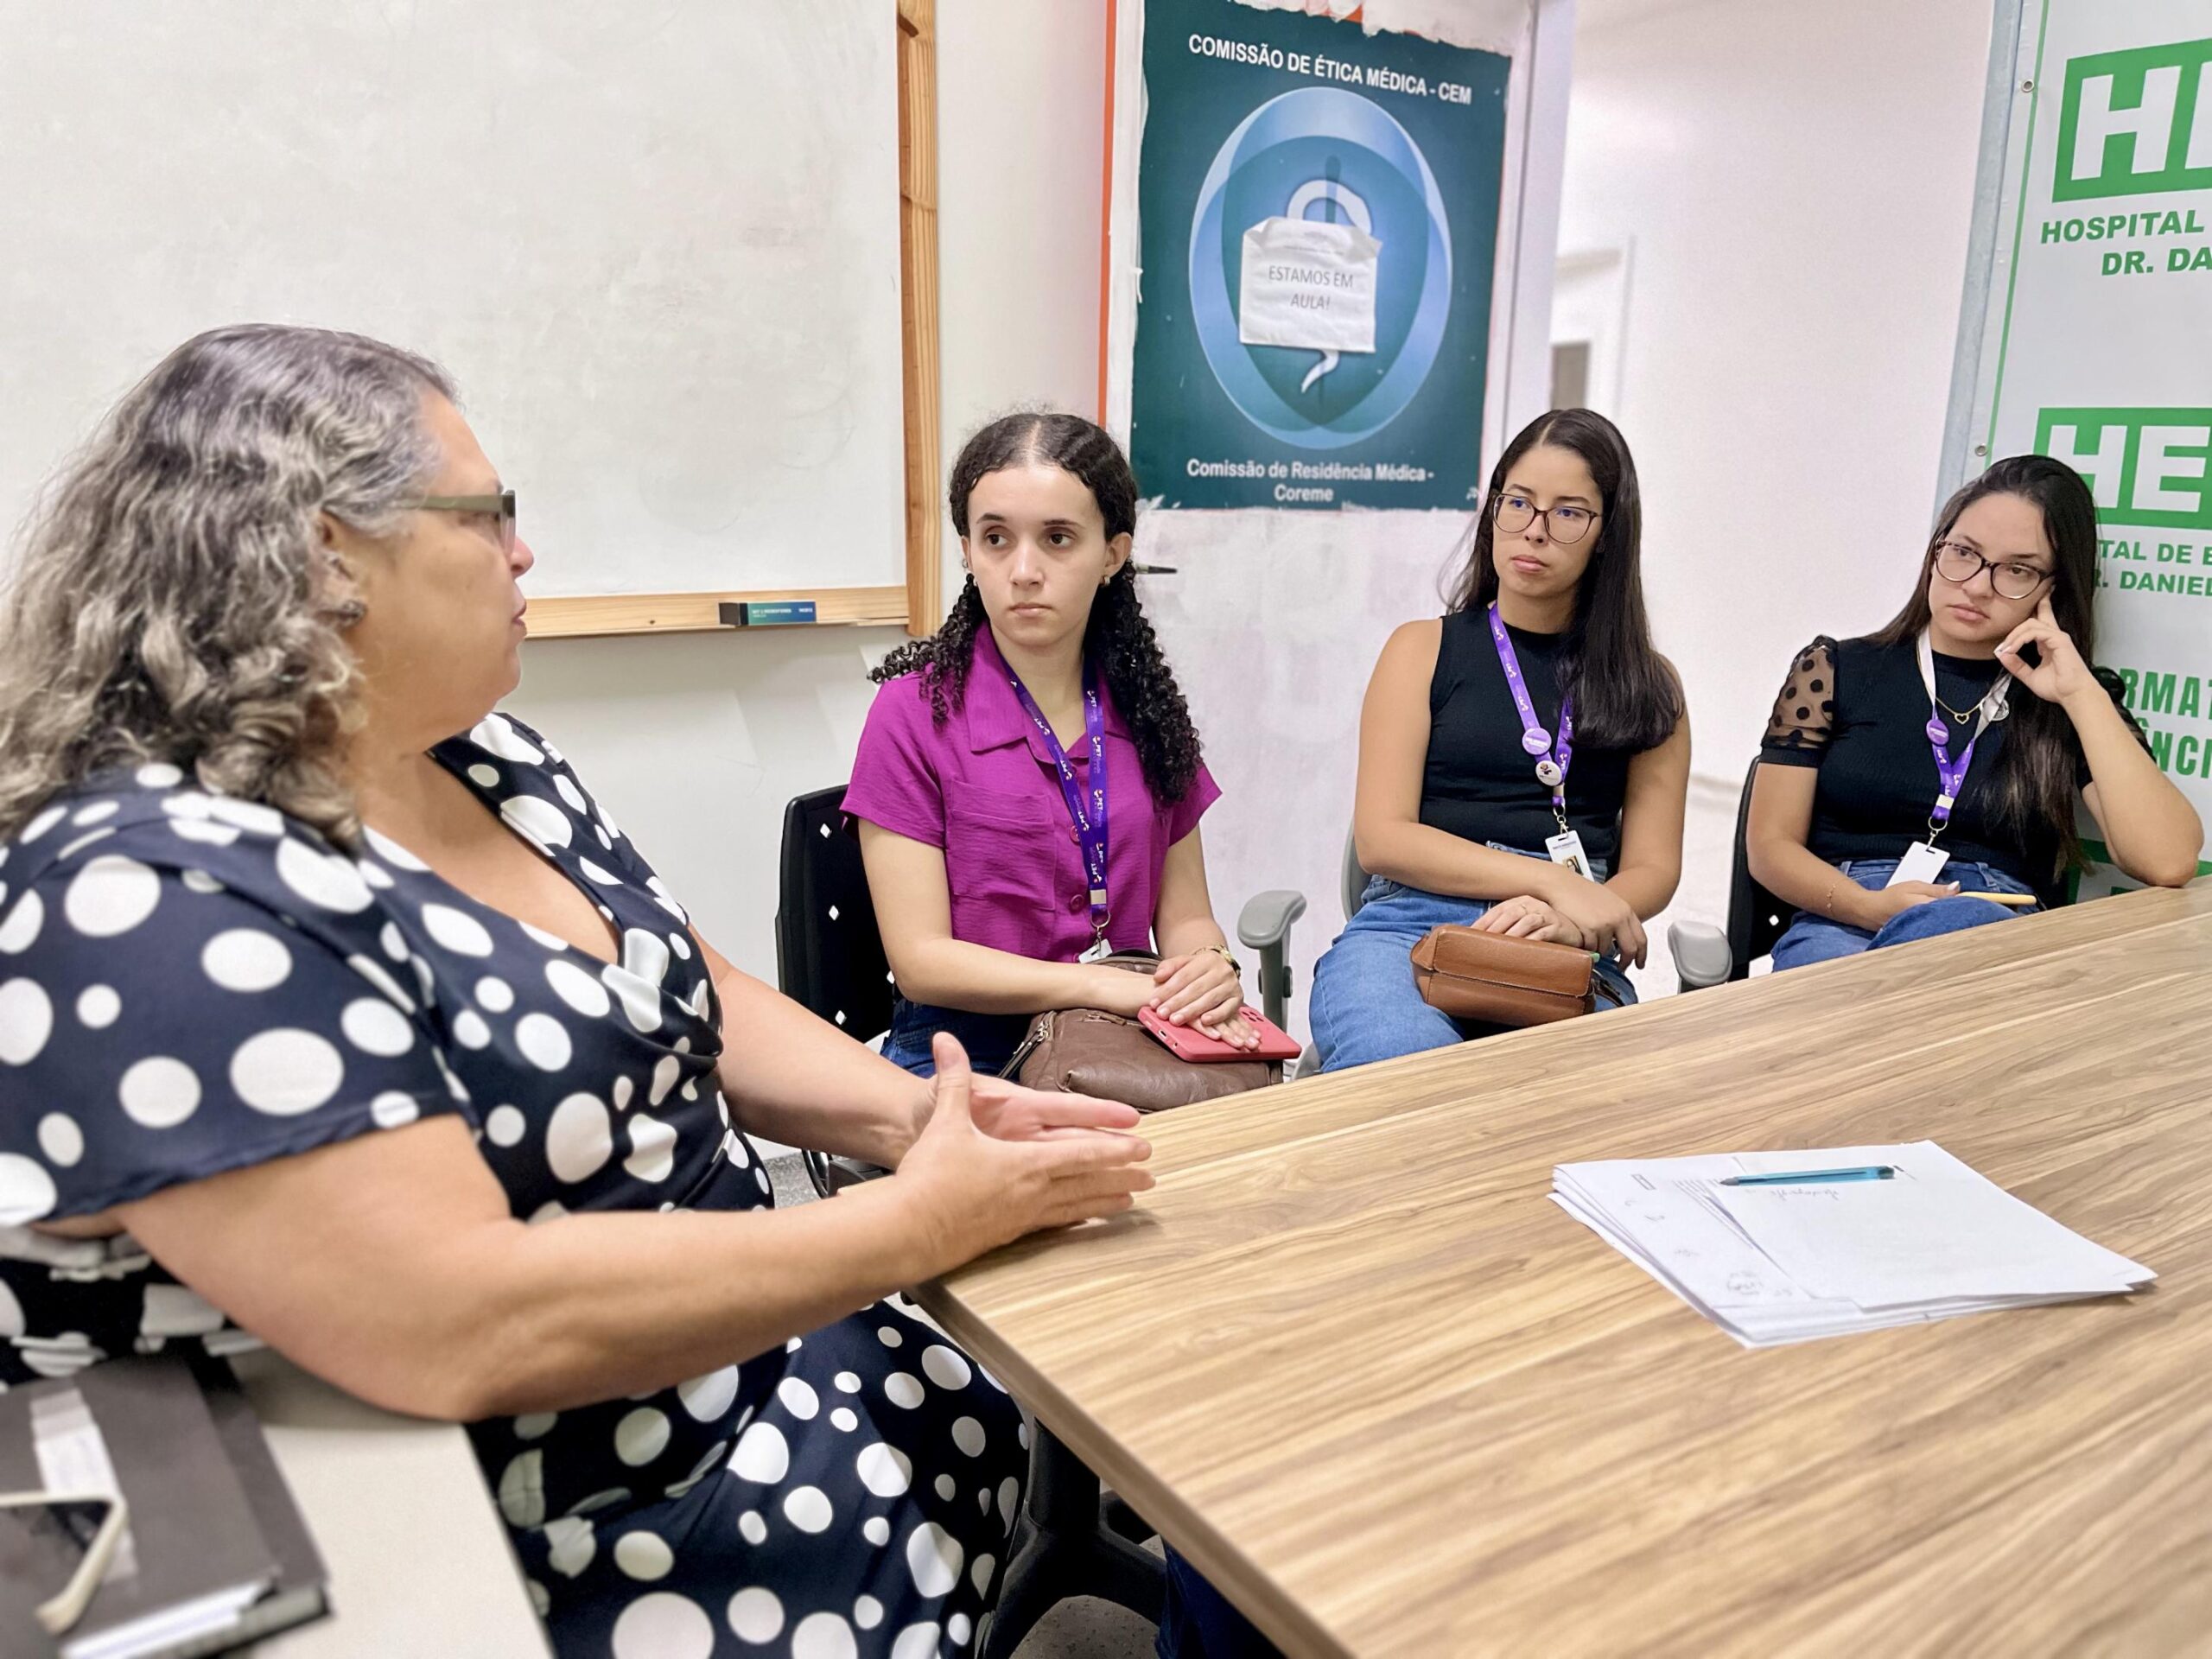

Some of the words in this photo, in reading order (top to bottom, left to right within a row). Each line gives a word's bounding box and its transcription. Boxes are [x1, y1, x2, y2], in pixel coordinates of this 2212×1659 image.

[1189, 34, 1283, 68] COMISSÃO
[1287, 52, 1311, 74] DE
[1314, 54, 1363, 84] ÉTICA
[1366, 67, 1427, 97] MÉDICA
[1438, 82, 1471, 105] CEM
[2041, 209, 2204, 244] HOSPITAL
[2101, 251, 2153, 276] DR.
[1268, 265, 1331, 286] ESTAMOS
[1333, 273, 1353, 288] EM
[1290, 294, 1331, 310] AULA!
[1186, 458, 1265, 478] Comissão
[1268, 461, 1287, 479] de
[1291, 461, 1373, 480] Residência
[1375, 463, 1426, 481] Médica
[1274, 483, 1334, 502] Coreme
[2157, 543, 2193, 564] DE
